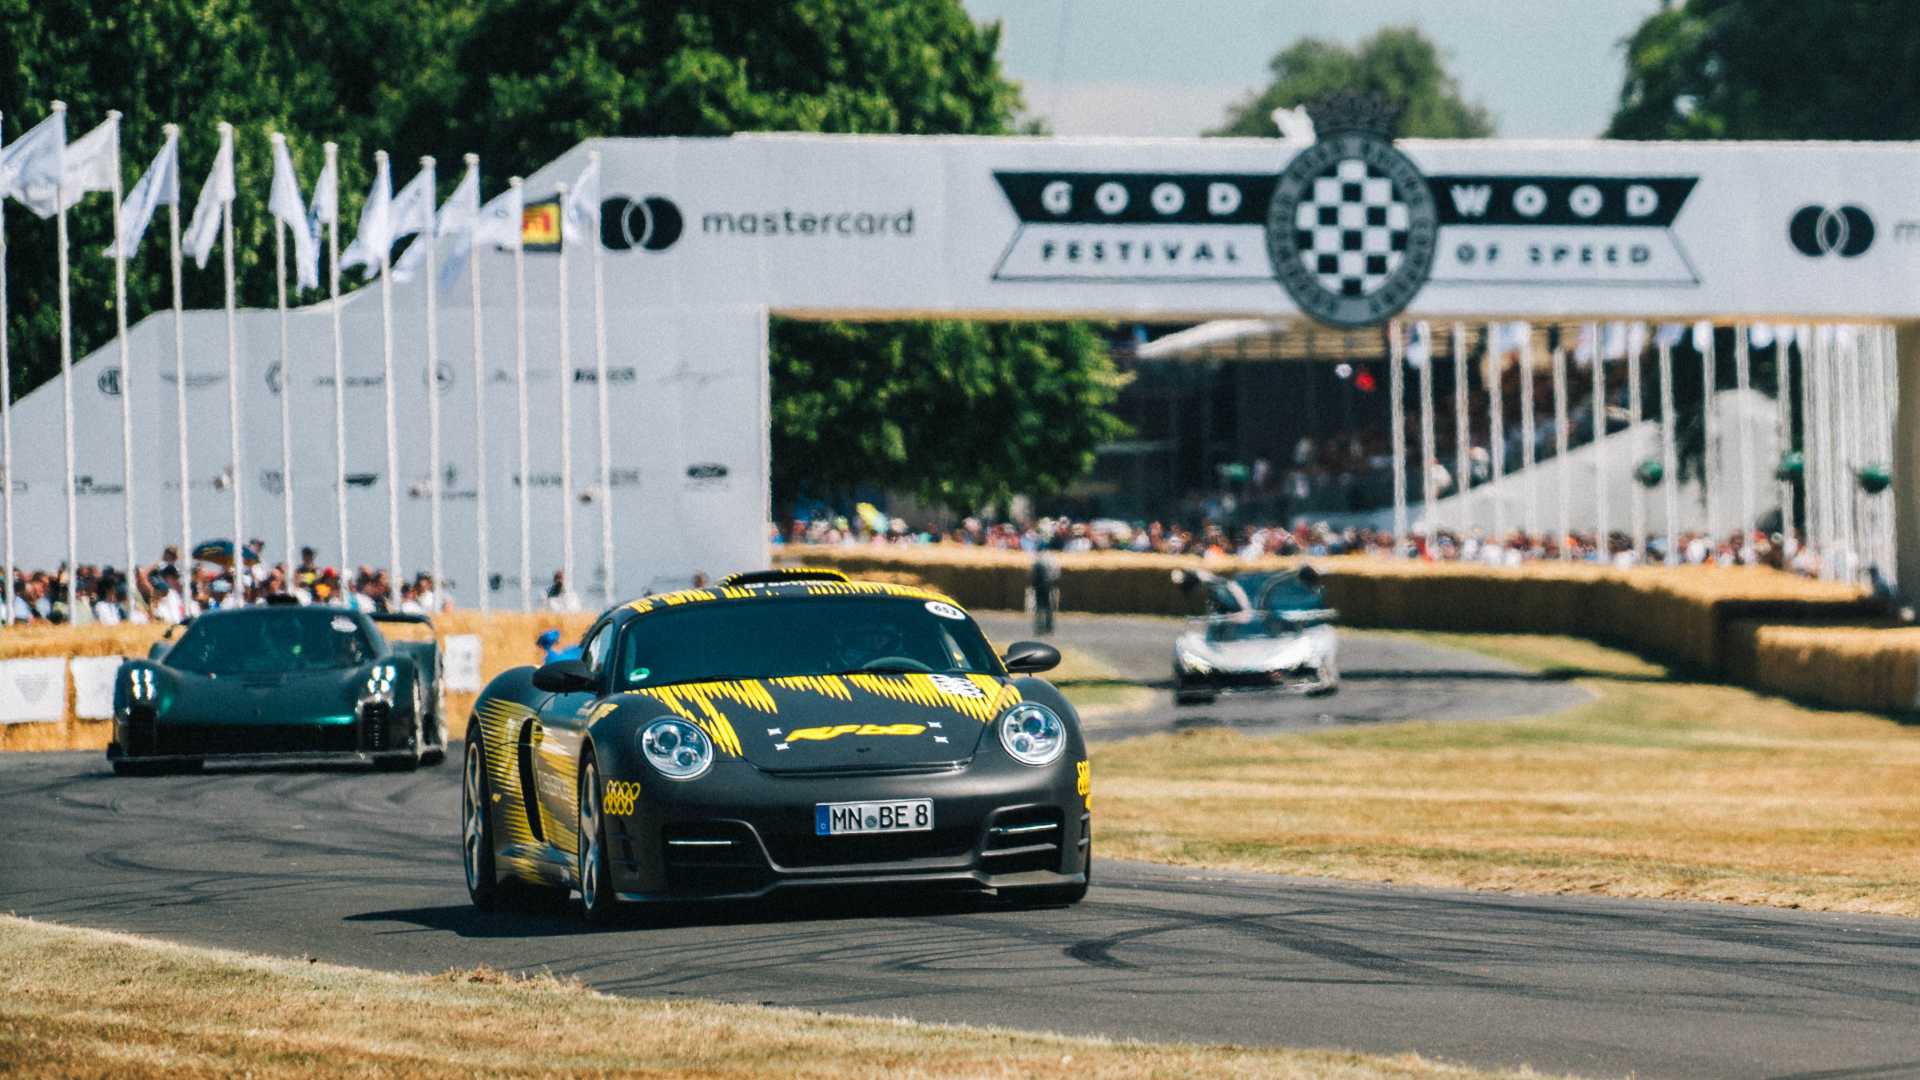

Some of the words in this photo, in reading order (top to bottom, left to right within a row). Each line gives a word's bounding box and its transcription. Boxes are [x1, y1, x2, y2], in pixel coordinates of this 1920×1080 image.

[1041, 181, 1242, 216] GOOD
[1449, 183, 1659, 218] WOOD
[703, 208, 915, 235] mastercard
[1042, 241, 1240, 263] FESTIVAL
[1455, 243, 1500, 264] OF
[1529, 243, 1652, 264] SPEED
[832, 807, 863, 830] MN
[879, 805, 909, 828] BE
[915, 803, 929, 826] 8
